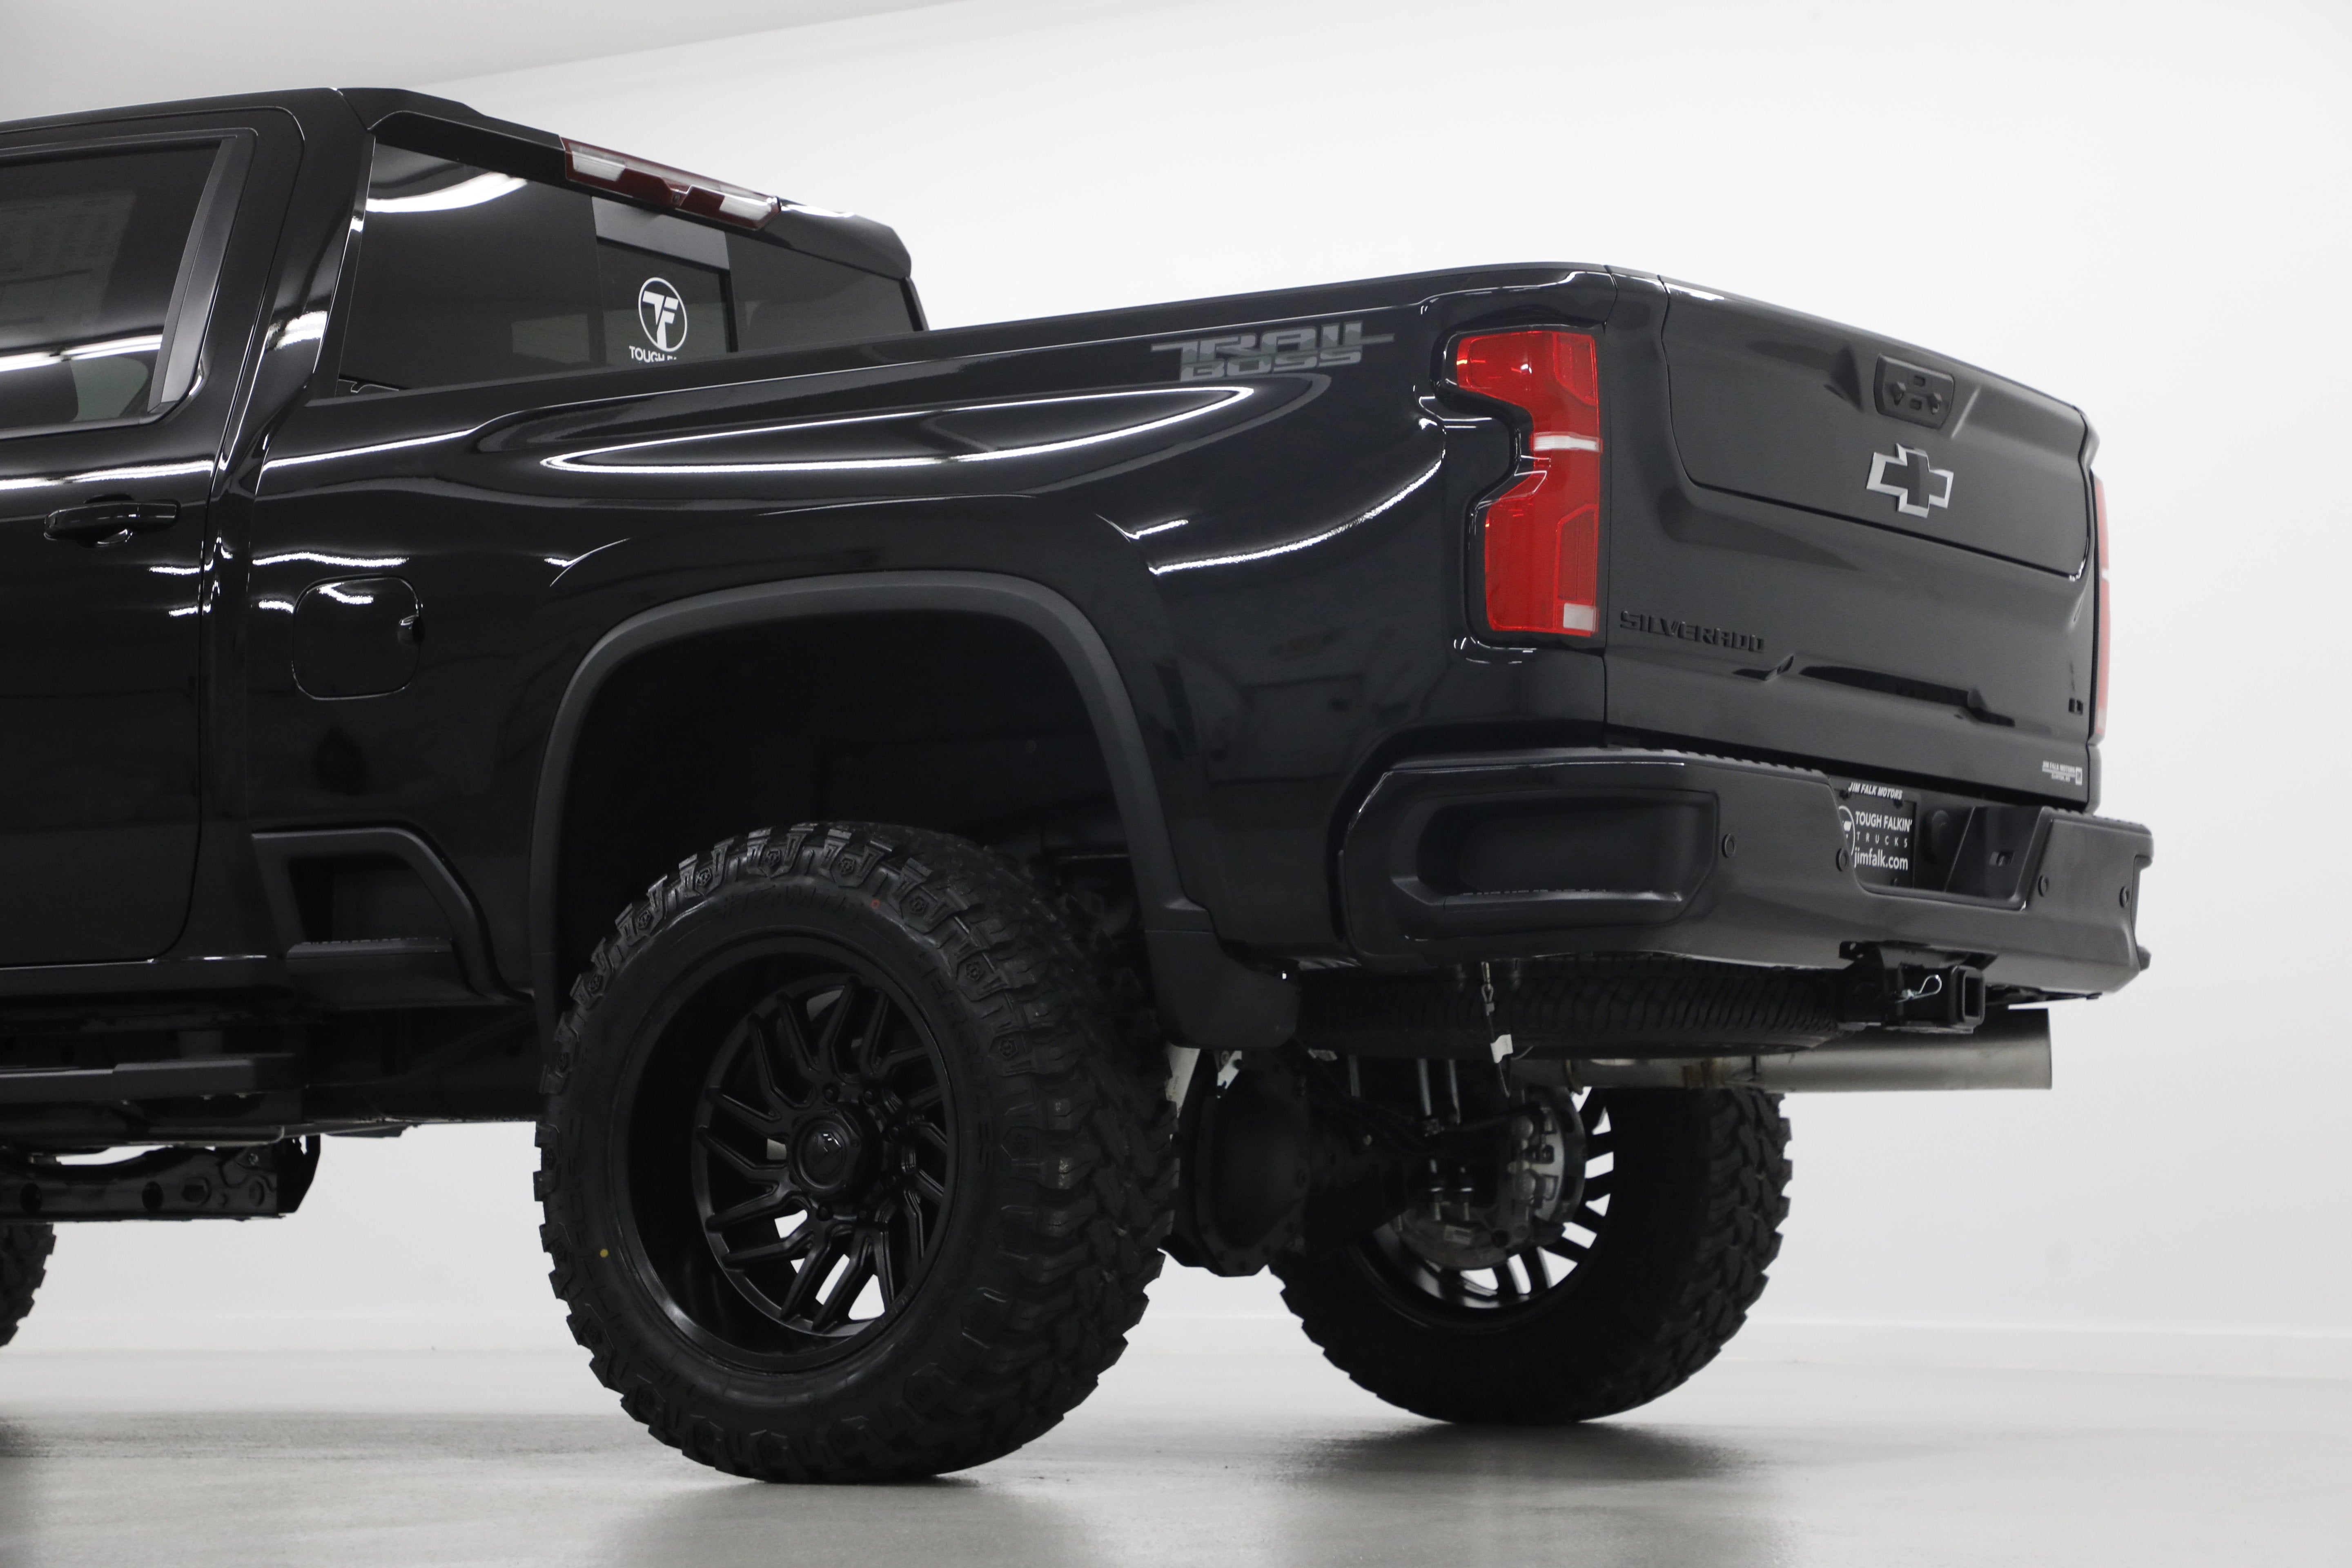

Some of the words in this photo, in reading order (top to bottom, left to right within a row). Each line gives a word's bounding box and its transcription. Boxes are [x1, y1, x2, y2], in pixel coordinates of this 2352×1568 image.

[629, 346, 665, 363] TOUGH
[1180, 348, 1363, 382] BOSS
[1620, 610, 1764, 652] SILVERADO
[1848, 782, 1861, 793] JIM
[1860, 784, 1878, 796] FALK
[1877, 786, 1903, 800] MOTORS
[1855, 811, 1882, 828] TOUGH
[1883, 815, 1913, 833] FALKIN'
[1857, 831, 1908, 848] TRUCKS
[1854, 847, 1908, 871] jimfalk.com
